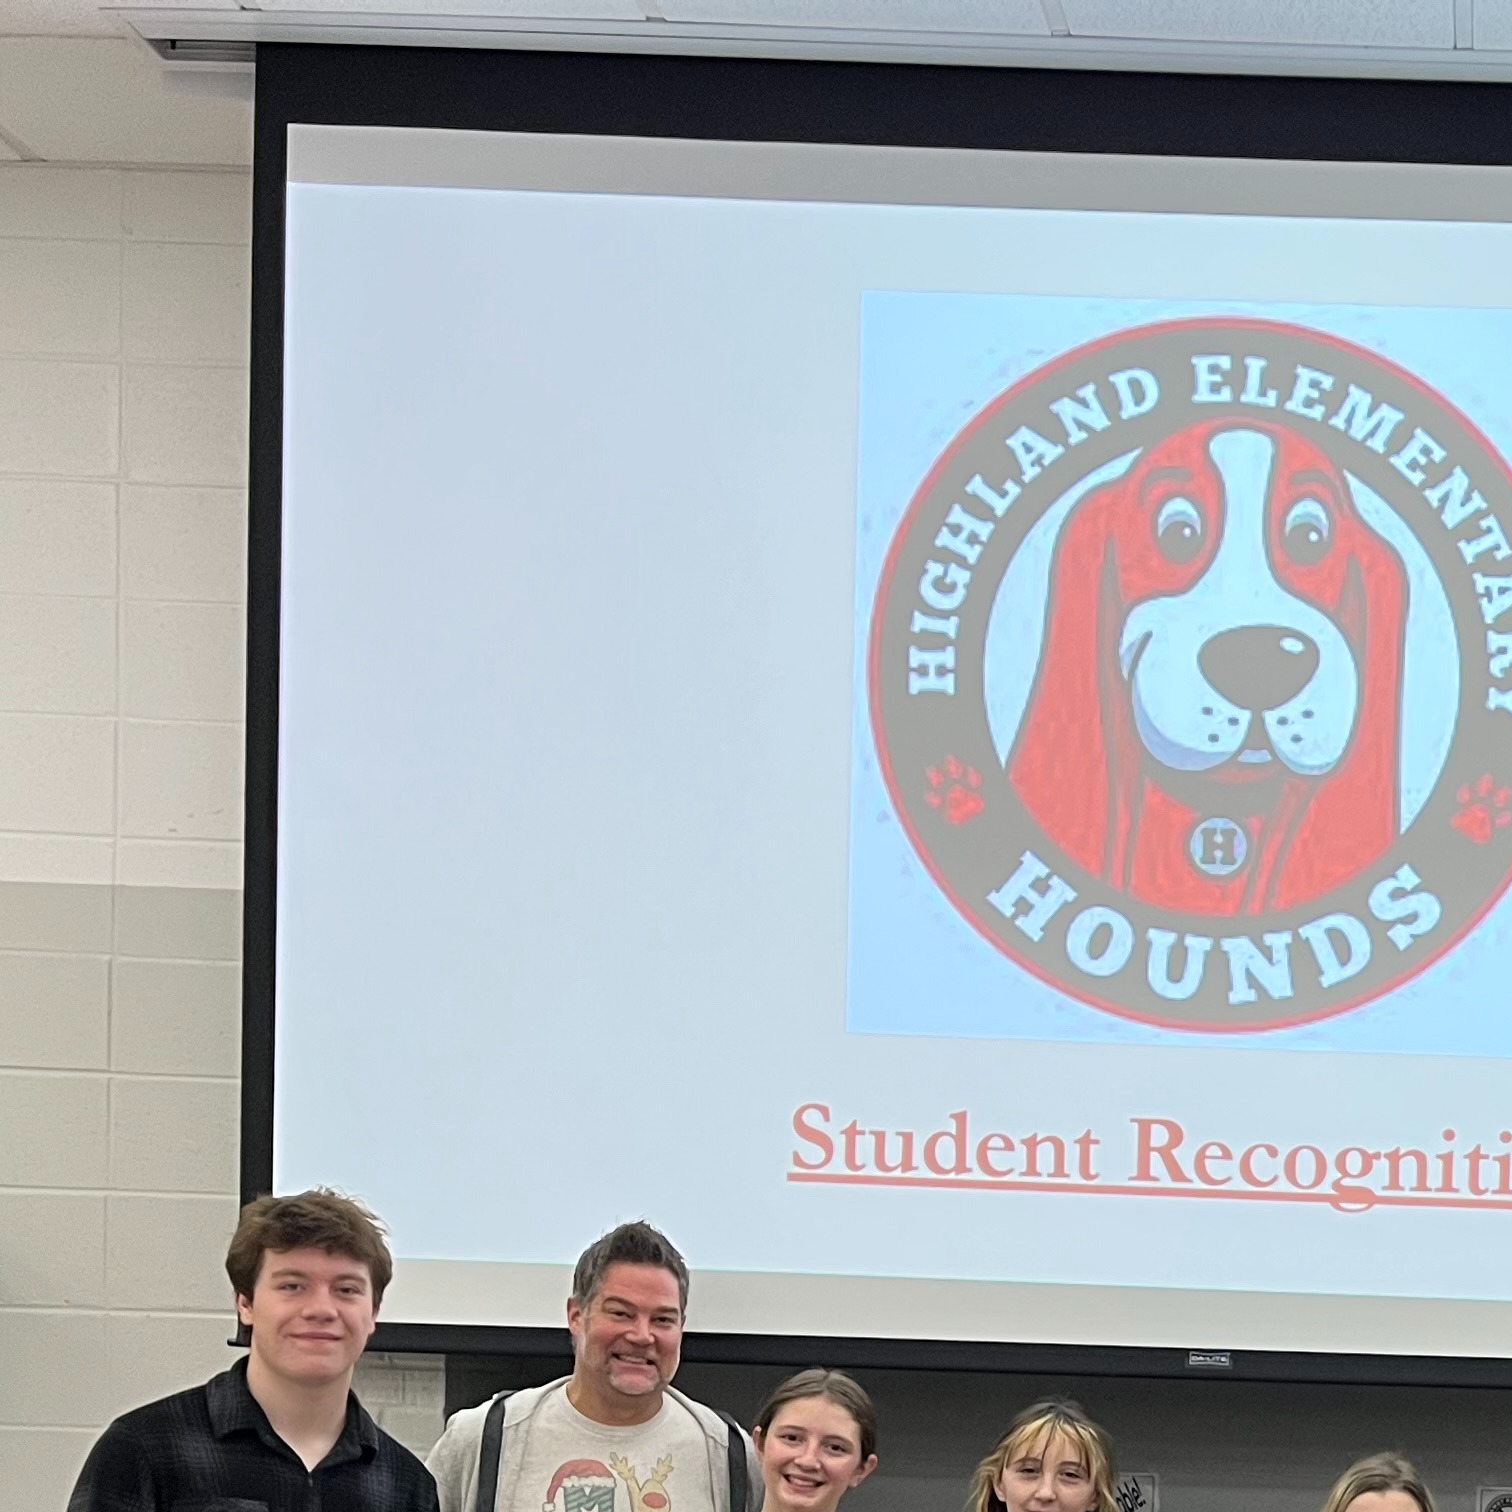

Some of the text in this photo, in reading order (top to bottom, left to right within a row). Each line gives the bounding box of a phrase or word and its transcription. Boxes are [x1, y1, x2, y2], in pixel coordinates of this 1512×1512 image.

[908, 366, 1159, 695] HIGHLAND
[1200, 827, 1240, 866] H
[987, 850, 1442, 1005] HOUNDS
[791, 1103, 1100, 1181] Student
